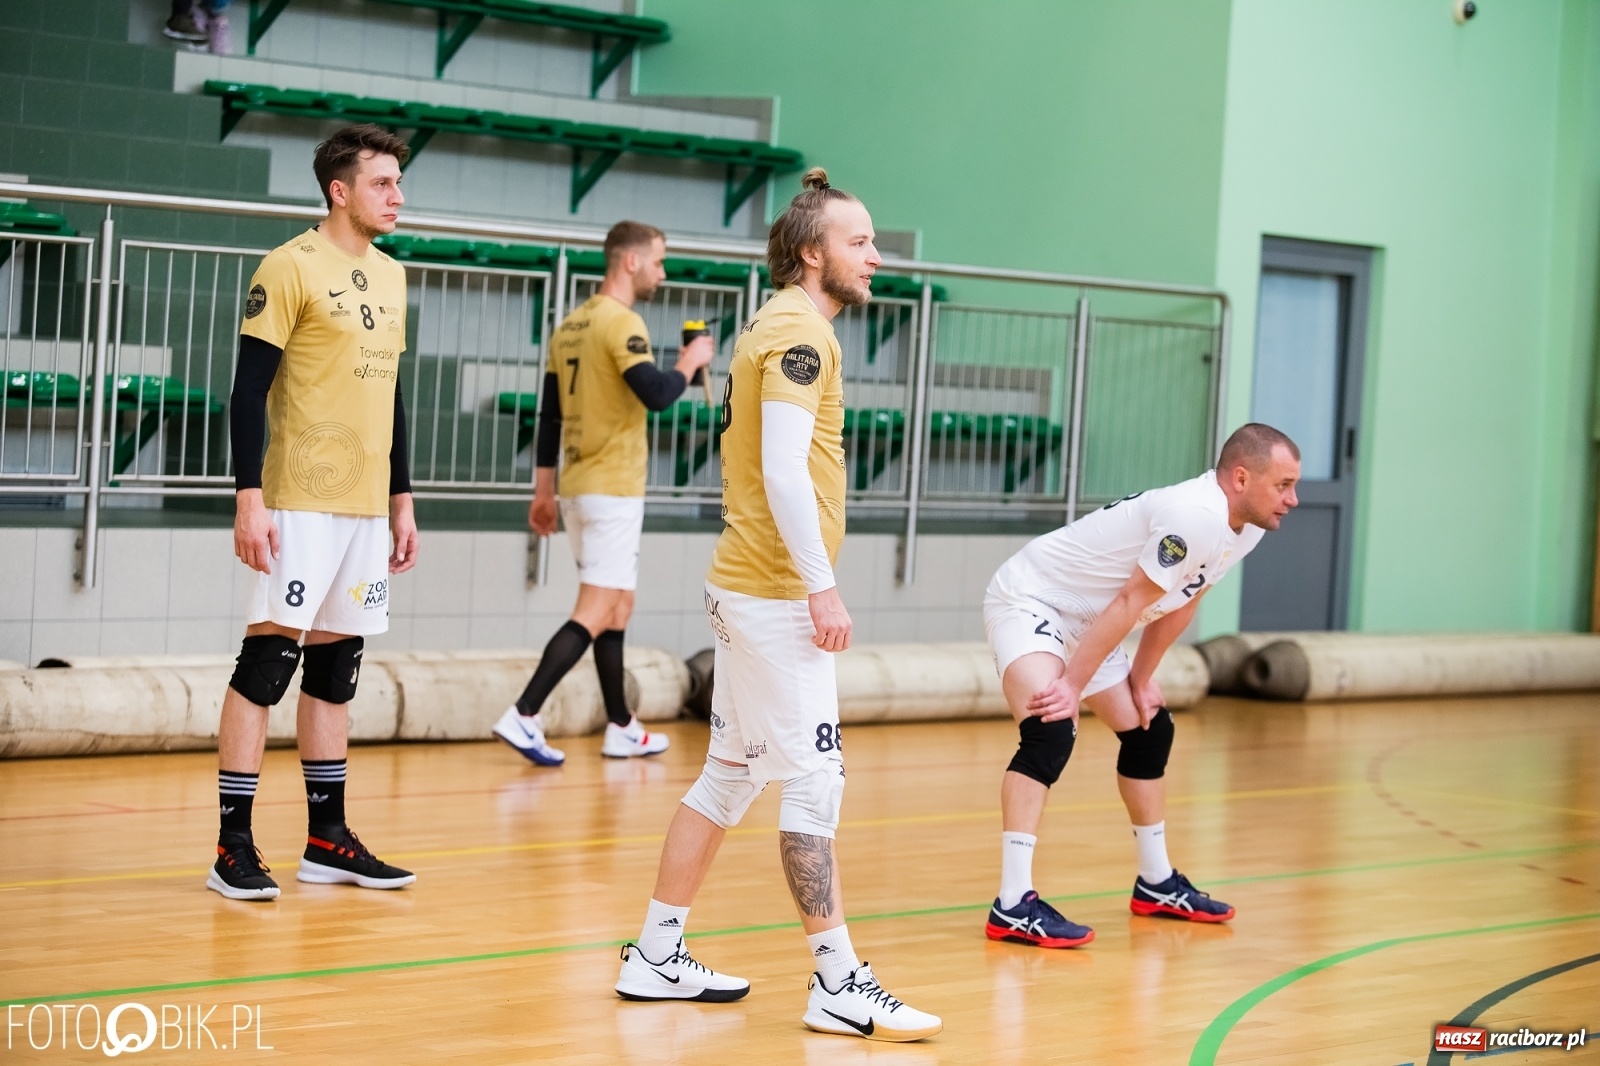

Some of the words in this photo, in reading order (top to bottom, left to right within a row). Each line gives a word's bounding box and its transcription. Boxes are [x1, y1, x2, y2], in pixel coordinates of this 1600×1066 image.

[360, 304, 375, 331] 8
[360, 346, 396, 360] Towalski
[785, 352, 819, 368] MILITARIA
[353, 363, 397, 382] eXchang
[796, 361, 809, 371] RTV
[566, 357, 580, 395] 7
[285, 579, 306, 607] 8
